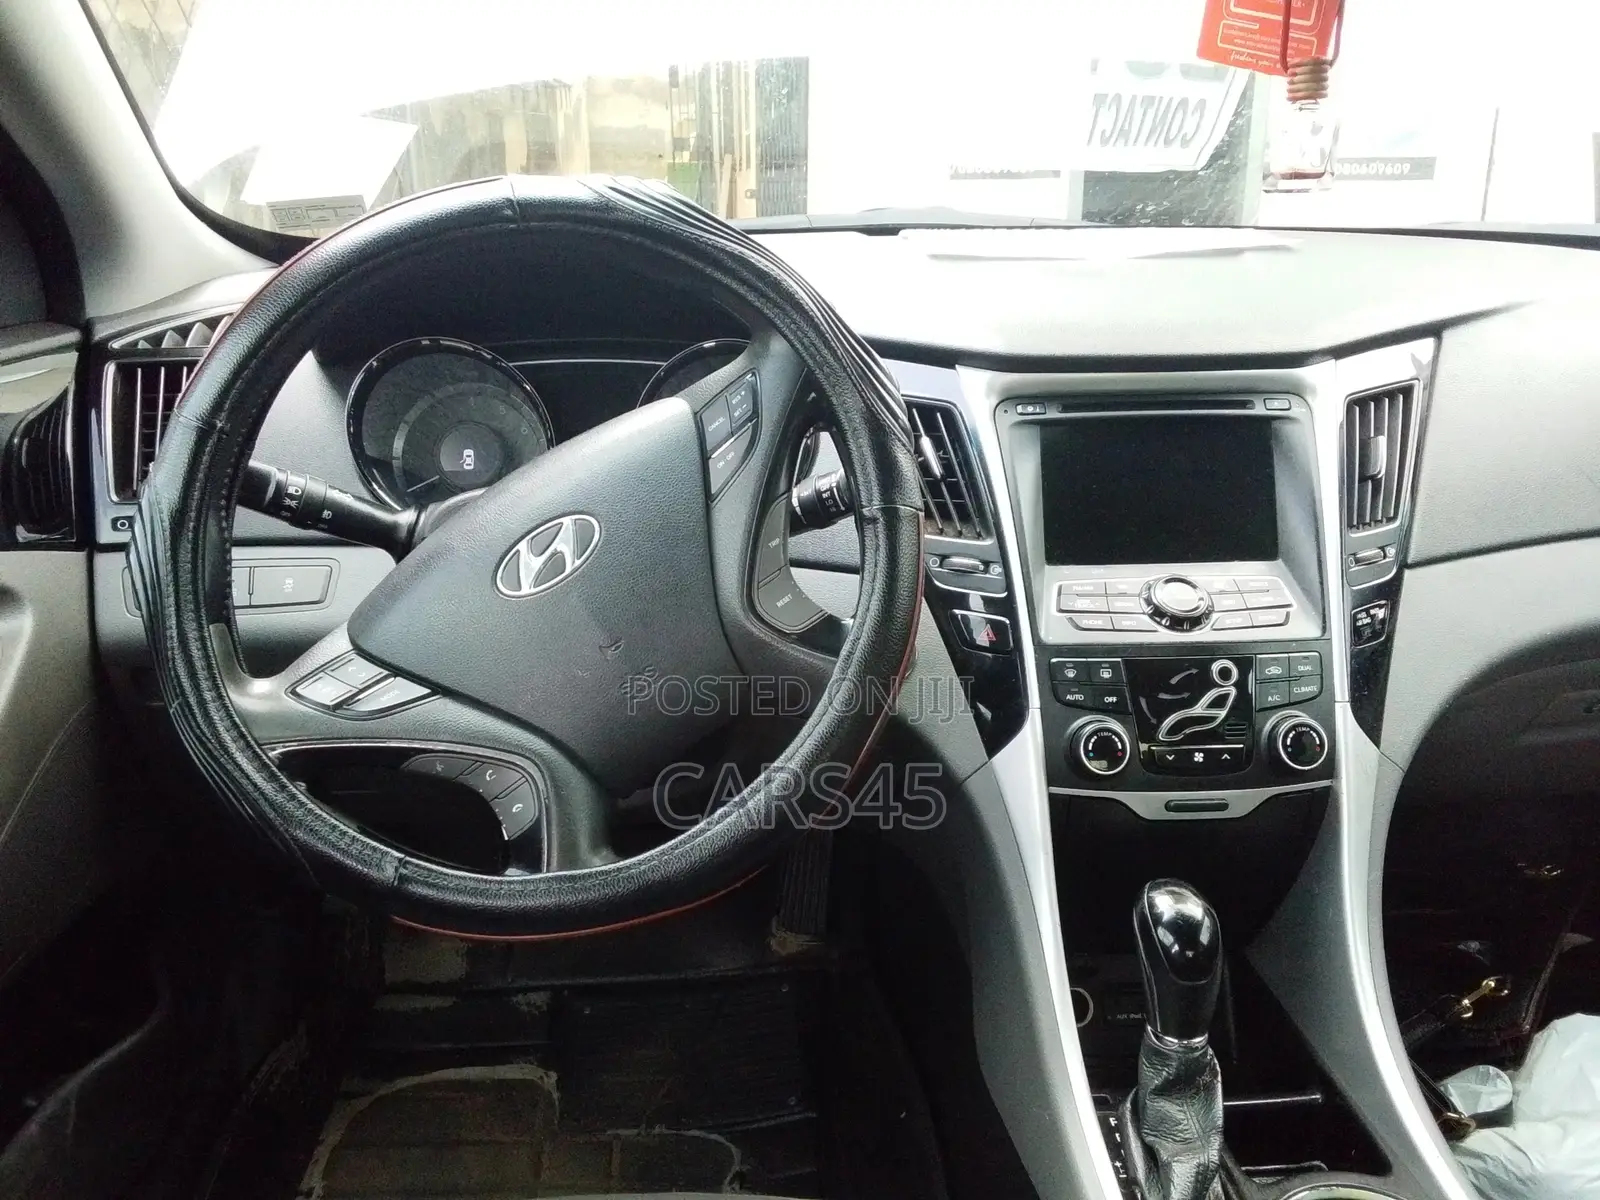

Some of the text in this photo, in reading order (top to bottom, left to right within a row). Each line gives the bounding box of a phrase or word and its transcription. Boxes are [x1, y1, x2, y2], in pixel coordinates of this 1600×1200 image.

[708, 415, 727, 432] CANCEL
[768, 537, 781, 549] TRIP
[775, 593, 793, 608] RESET
[1293, 685, 1318, 693] CLIMATE
[1267, 694, 1281, 702] A/C
